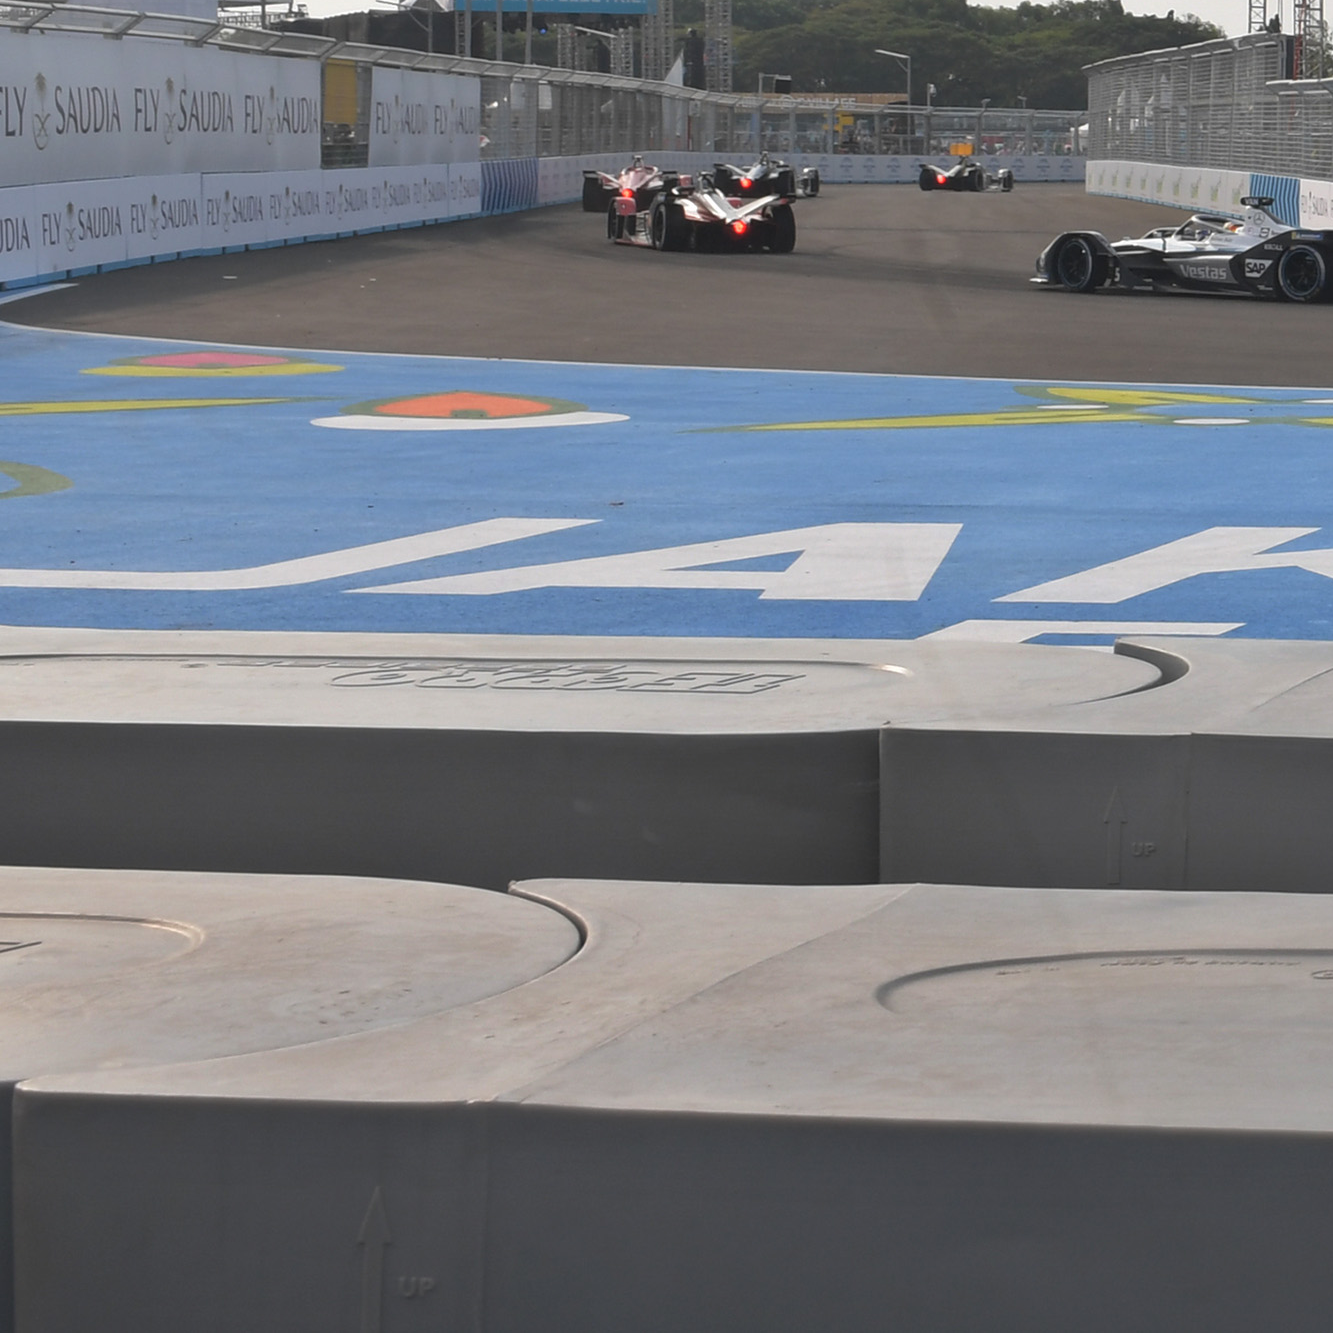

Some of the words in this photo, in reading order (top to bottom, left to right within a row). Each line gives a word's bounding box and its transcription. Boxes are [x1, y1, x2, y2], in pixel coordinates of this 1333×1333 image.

[0, 86, 27, 137] LY
[55, 85, 121, 135] SAUDIA
[134, 88, 160, 132] FLY
[177, 89, 234, 133] SAUDIA
[244, 95, 265, 134] FLY
[376, 101, 393, 134] FLY
[131, 204, 147, 233] FLY
[161, 199, 199, 230] SAUDIA
[207, 199, 222, 226] FLY
[232, 196, 263, 223] SAUDIA
[270, 195, 282, 219] FLY
[42, 213, 62, 246] FLY
[78, 207, 122, 241] SAUDIA
[1180, 264, 1227, 280] Vestas
[1246, 262, 1266, 274] SAP
[398, 1276, 436, 1297] UP
